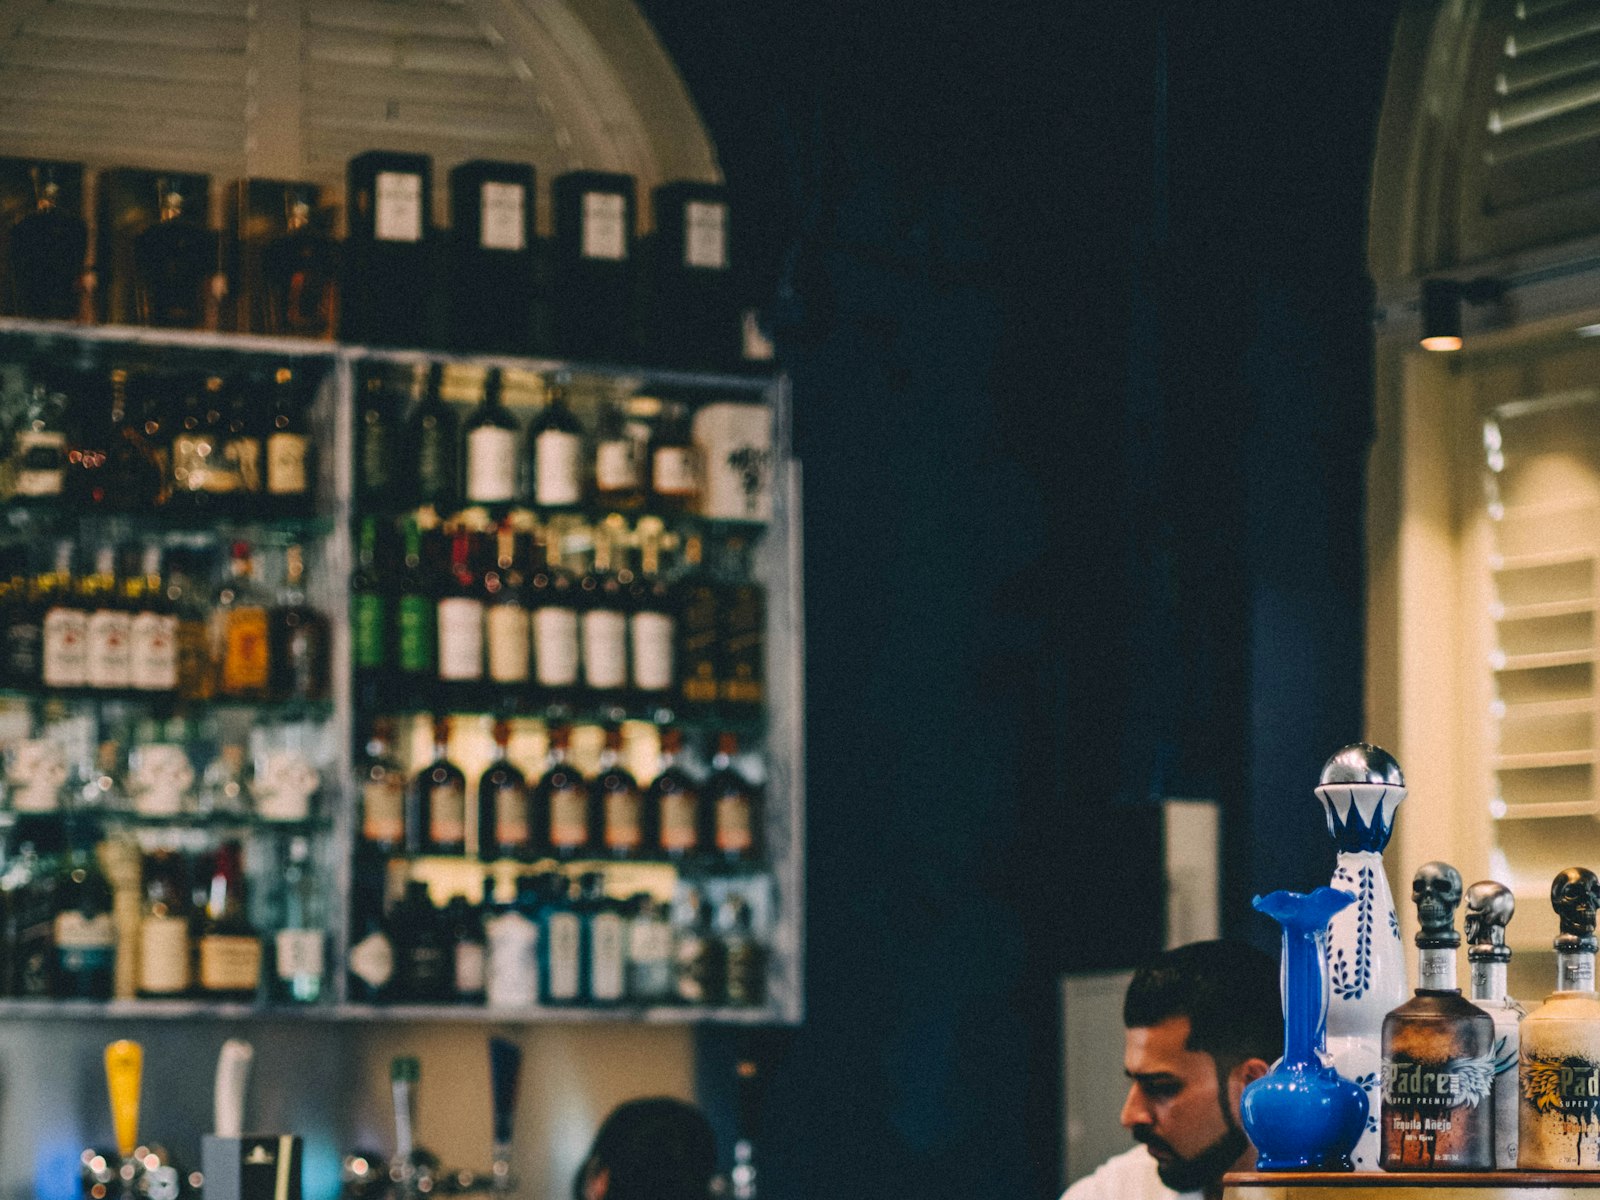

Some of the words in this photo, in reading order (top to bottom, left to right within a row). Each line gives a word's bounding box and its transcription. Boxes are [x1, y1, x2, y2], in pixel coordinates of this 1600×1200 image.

[1389, 1063, 1450, 1094] Padre
[1393, 1118, 1422, 1132] Tequila
[1425, 1117, 1452, 1133] Añejo
